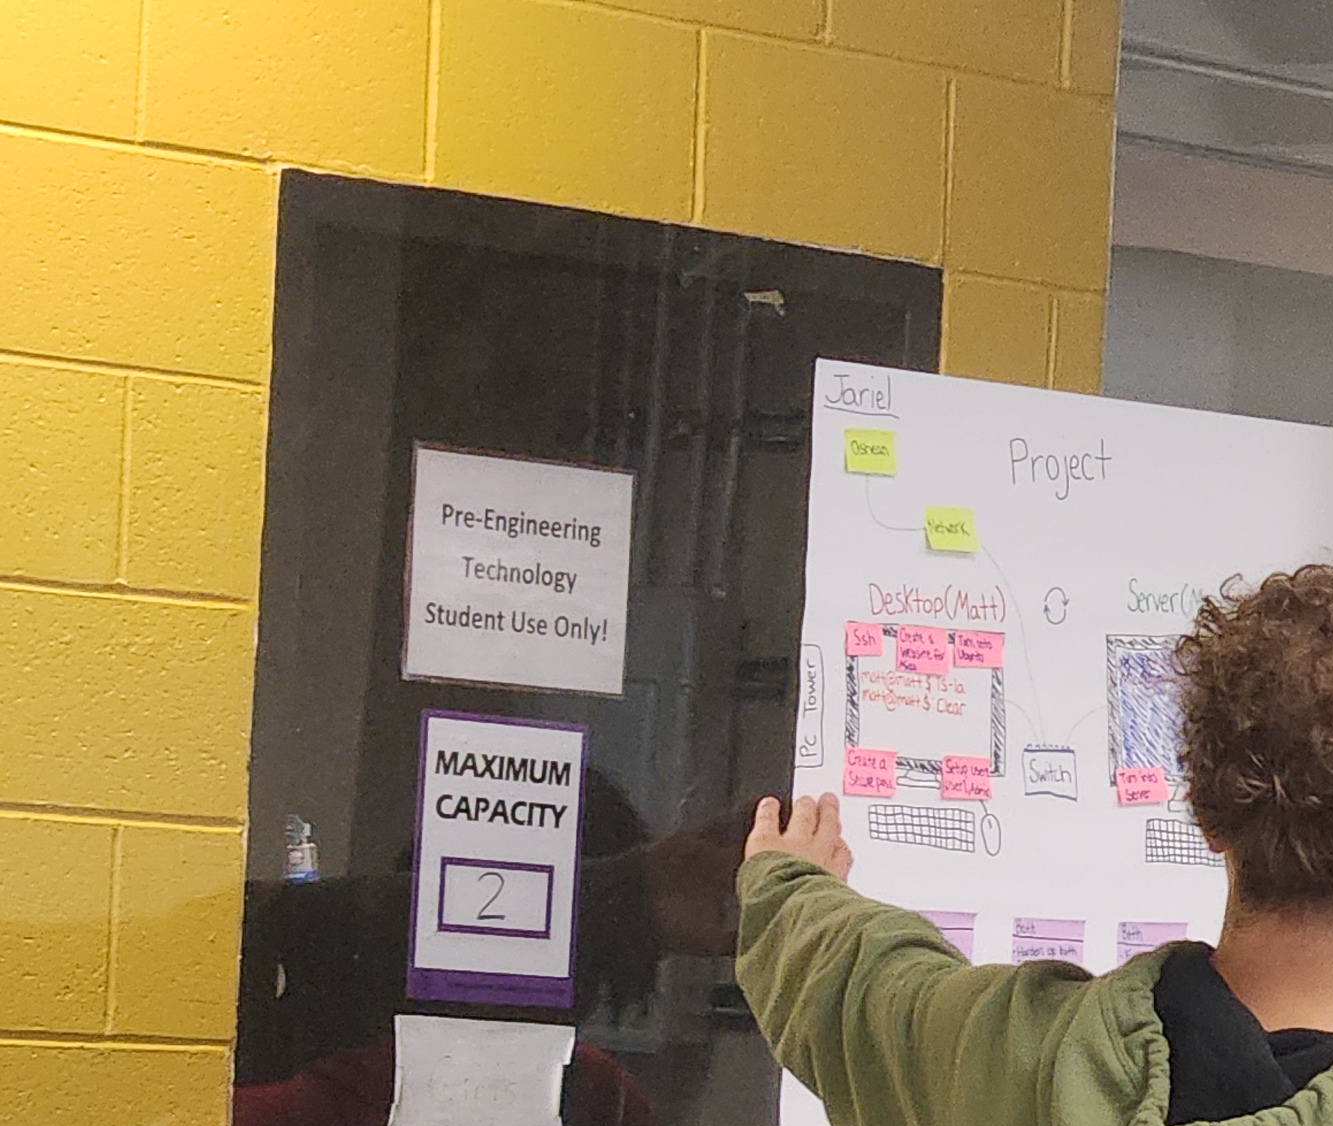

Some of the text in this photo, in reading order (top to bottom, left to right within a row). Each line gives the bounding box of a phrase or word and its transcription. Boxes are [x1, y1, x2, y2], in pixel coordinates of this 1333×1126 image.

[825, 374, 891, 412] Jariel
[1009, 437, 1113, 501] Project
[441, 503, 602, 548] Pre-Engineering
[462, 556, 577, 595] Technology
[424, 602, 608, 646] Student Use Only!
[803, 660, 818, 718] Tower
[434, 750, 572, 787] MAXIMUM
[1029, 759, 1072, 785] Switch
[435, 794, 568, 829] CAPACITY
[476, 871, 507, 921] 2
